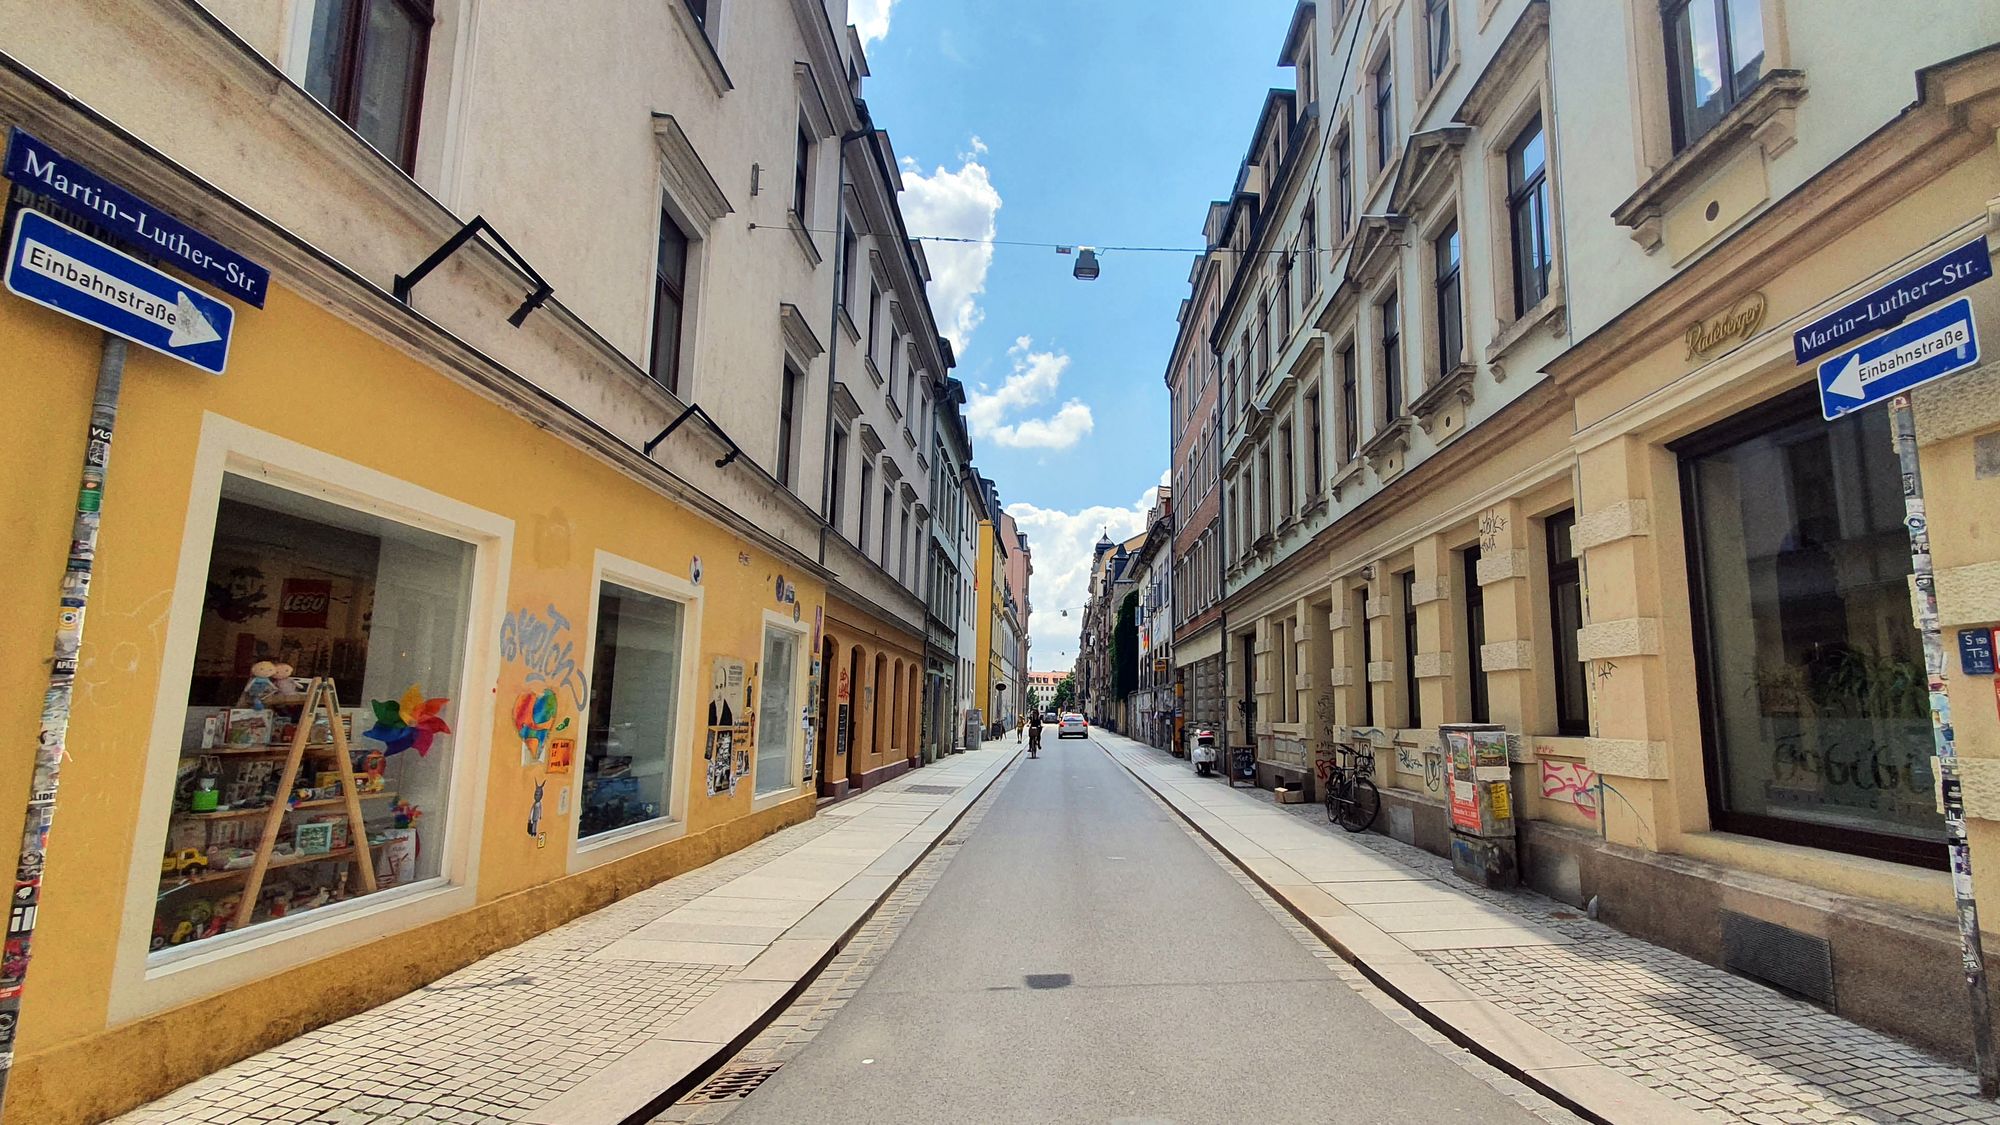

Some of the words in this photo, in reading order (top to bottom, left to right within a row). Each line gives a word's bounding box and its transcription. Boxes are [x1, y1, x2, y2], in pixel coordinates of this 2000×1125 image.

[24, 148, 258, 295] Martin-Luther-Str.
[29, 247, 177, 326] Einbahnstraße
[1800, 259, 1979, 353] Martin-Luther-Str.
[1858, 329, 1964, 382] Einbahnstraße
